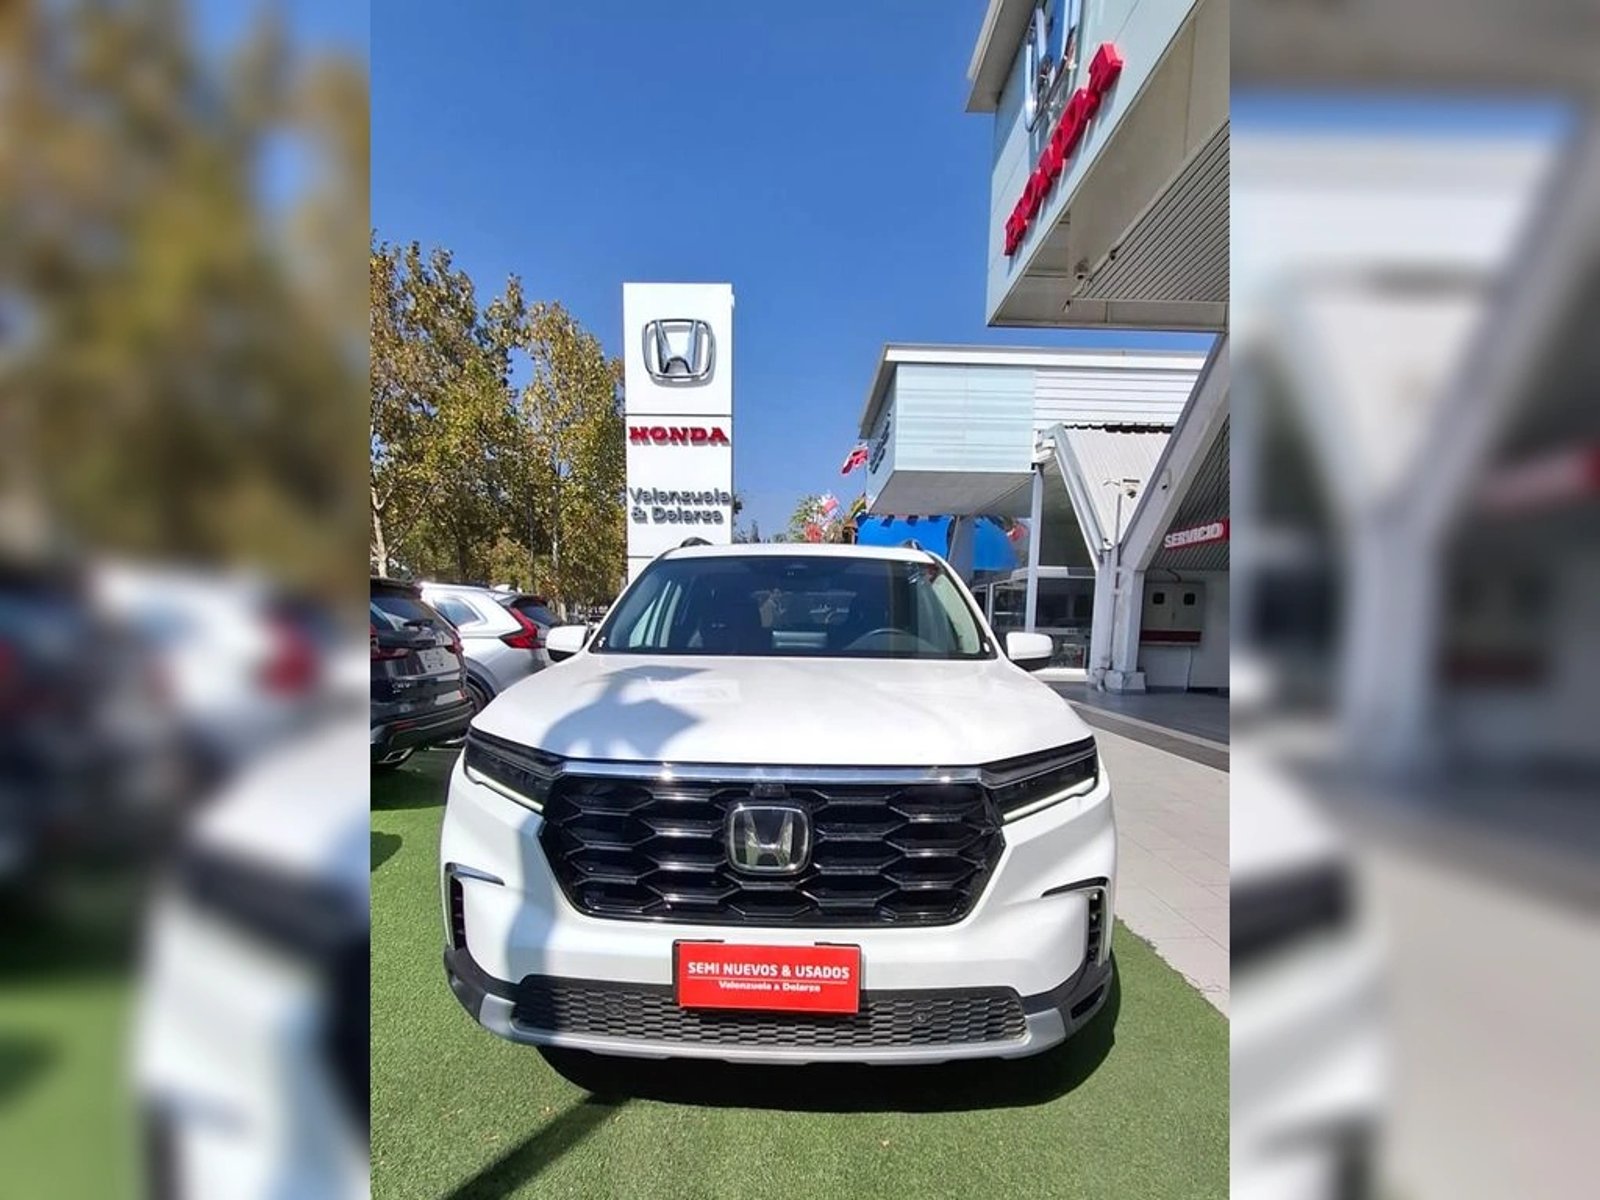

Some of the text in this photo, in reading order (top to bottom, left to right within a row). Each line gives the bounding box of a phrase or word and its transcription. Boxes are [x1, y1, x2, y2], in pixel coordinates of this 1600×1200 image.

[629, 426, 730, 445] HONDA
[629, 487, 731, 505] Valenzuela
[631, 506, 648, 523] &
[1164, 523, 1224, 548] SERVICIO
[688, 961, 850, 979] SEMI NUEVOS & USADOS
[719, 981, 772, 991] Valenzuela
